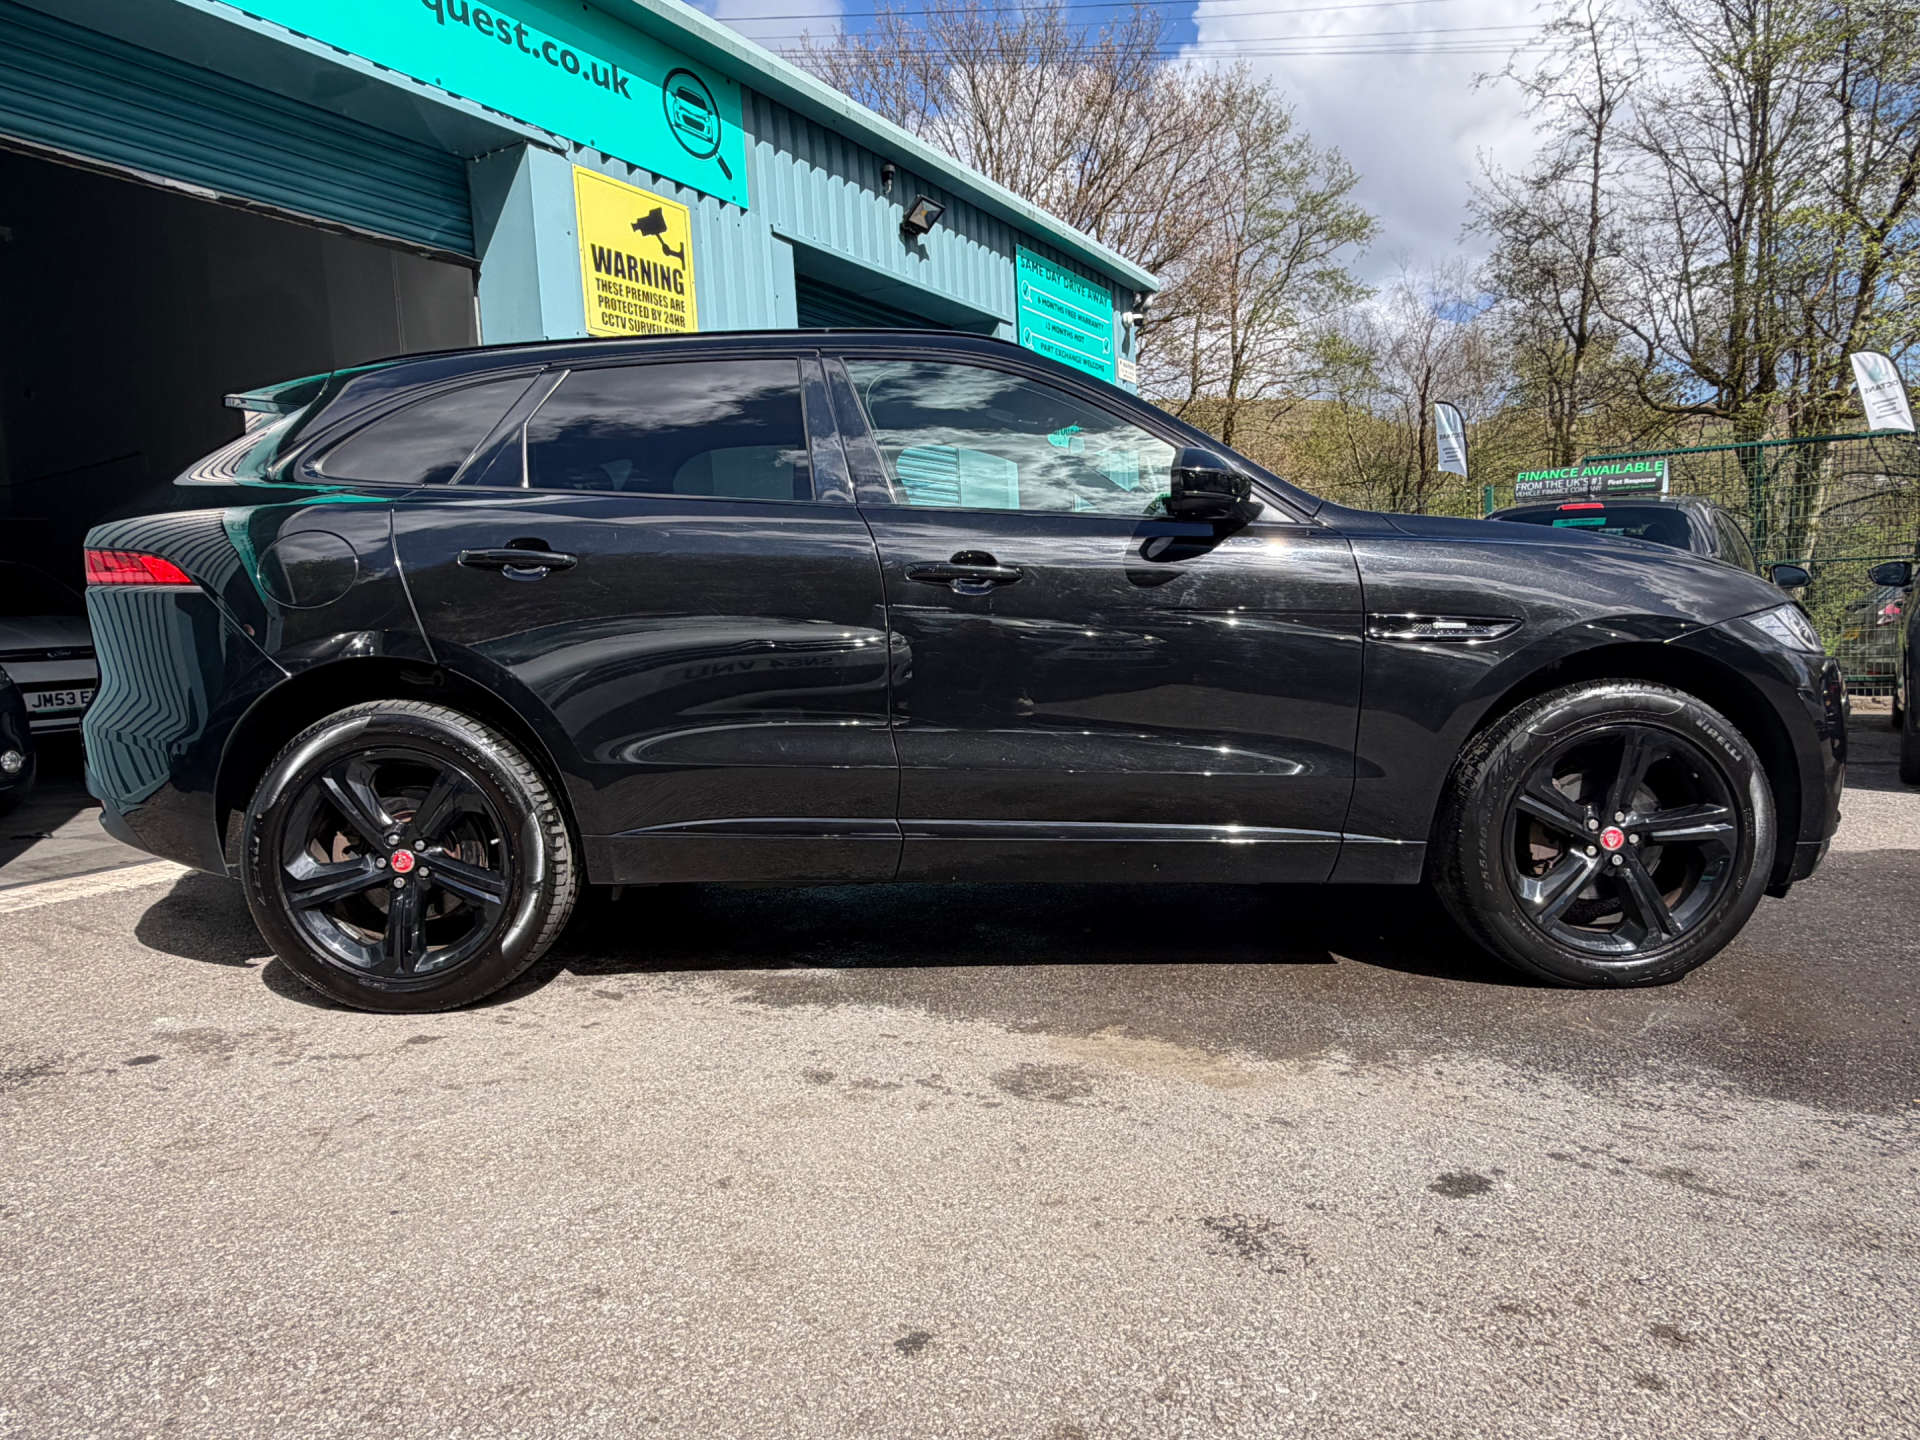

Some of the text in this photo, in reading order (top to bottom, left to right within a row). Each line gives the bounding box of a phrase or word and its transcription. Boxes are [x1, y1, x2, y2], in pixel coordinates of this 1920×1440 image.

[590, 243, 685, 296] WARNING
[1020, 256, 1045, 277] SAME
[1046, 269, 1061, 285] DAY
[595, 277, 686, 313] THESE PREMISES ARE
[598, 295, 686, 328] PROTECTED BY 24HR
[601, 311, 627, 329] CCTV
[1517, 460, 1665, 482] FINANCE AVAILABLE
[1515, 481, 1543, 491] FROM
[1545, 479, 1564, 489] THE
[1566, 477, 1589, 488] UK'S
[32, 692, 76, 708] JM53
